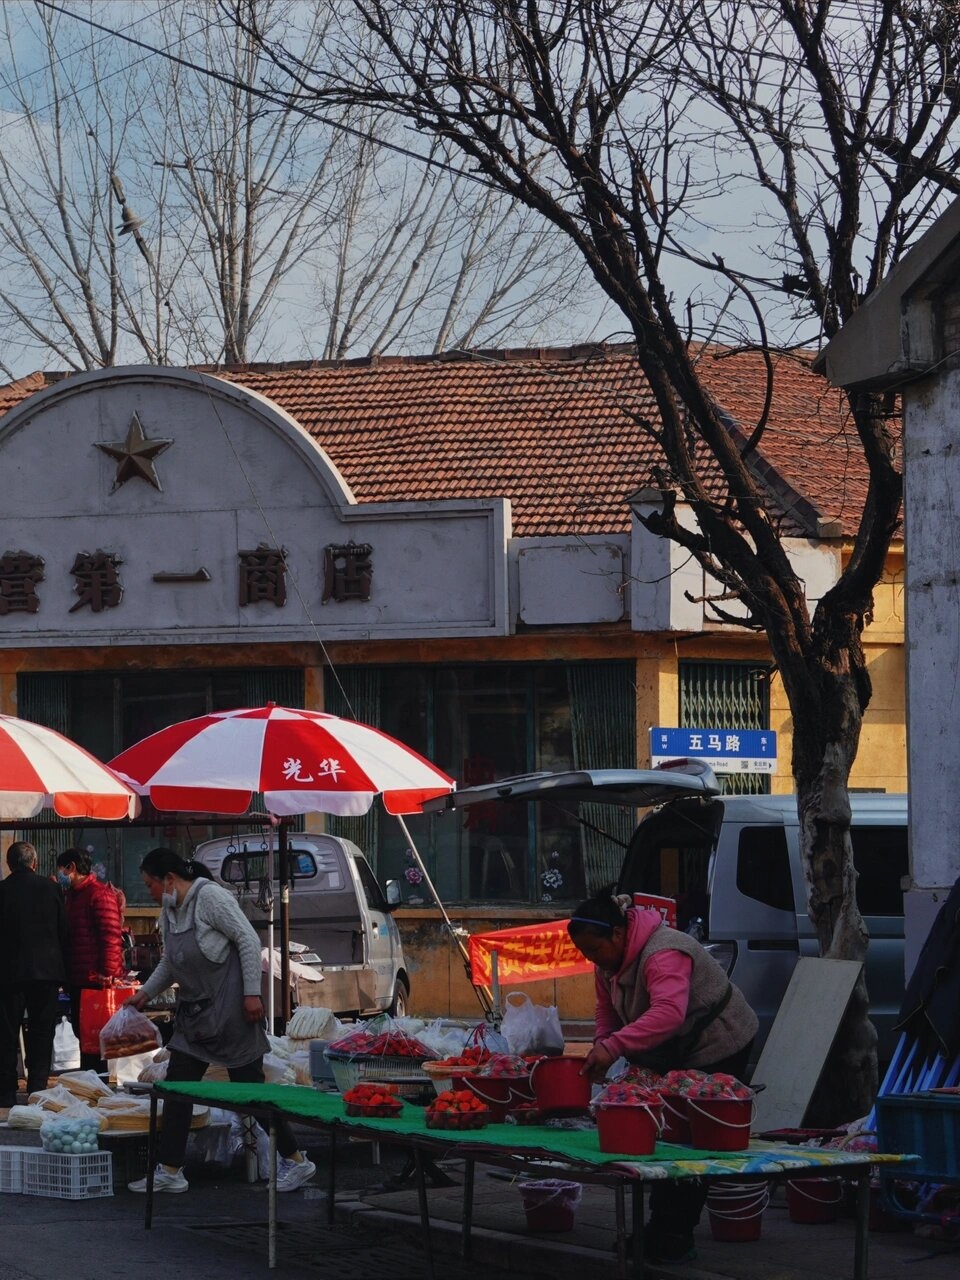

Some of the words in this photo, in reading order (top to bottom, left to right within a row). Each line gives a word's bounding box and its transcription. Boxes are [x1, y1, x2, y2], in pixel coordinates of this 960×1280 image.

[689, 734, 741, 752] 五马路
[281, 756, 347, 784] 光华
